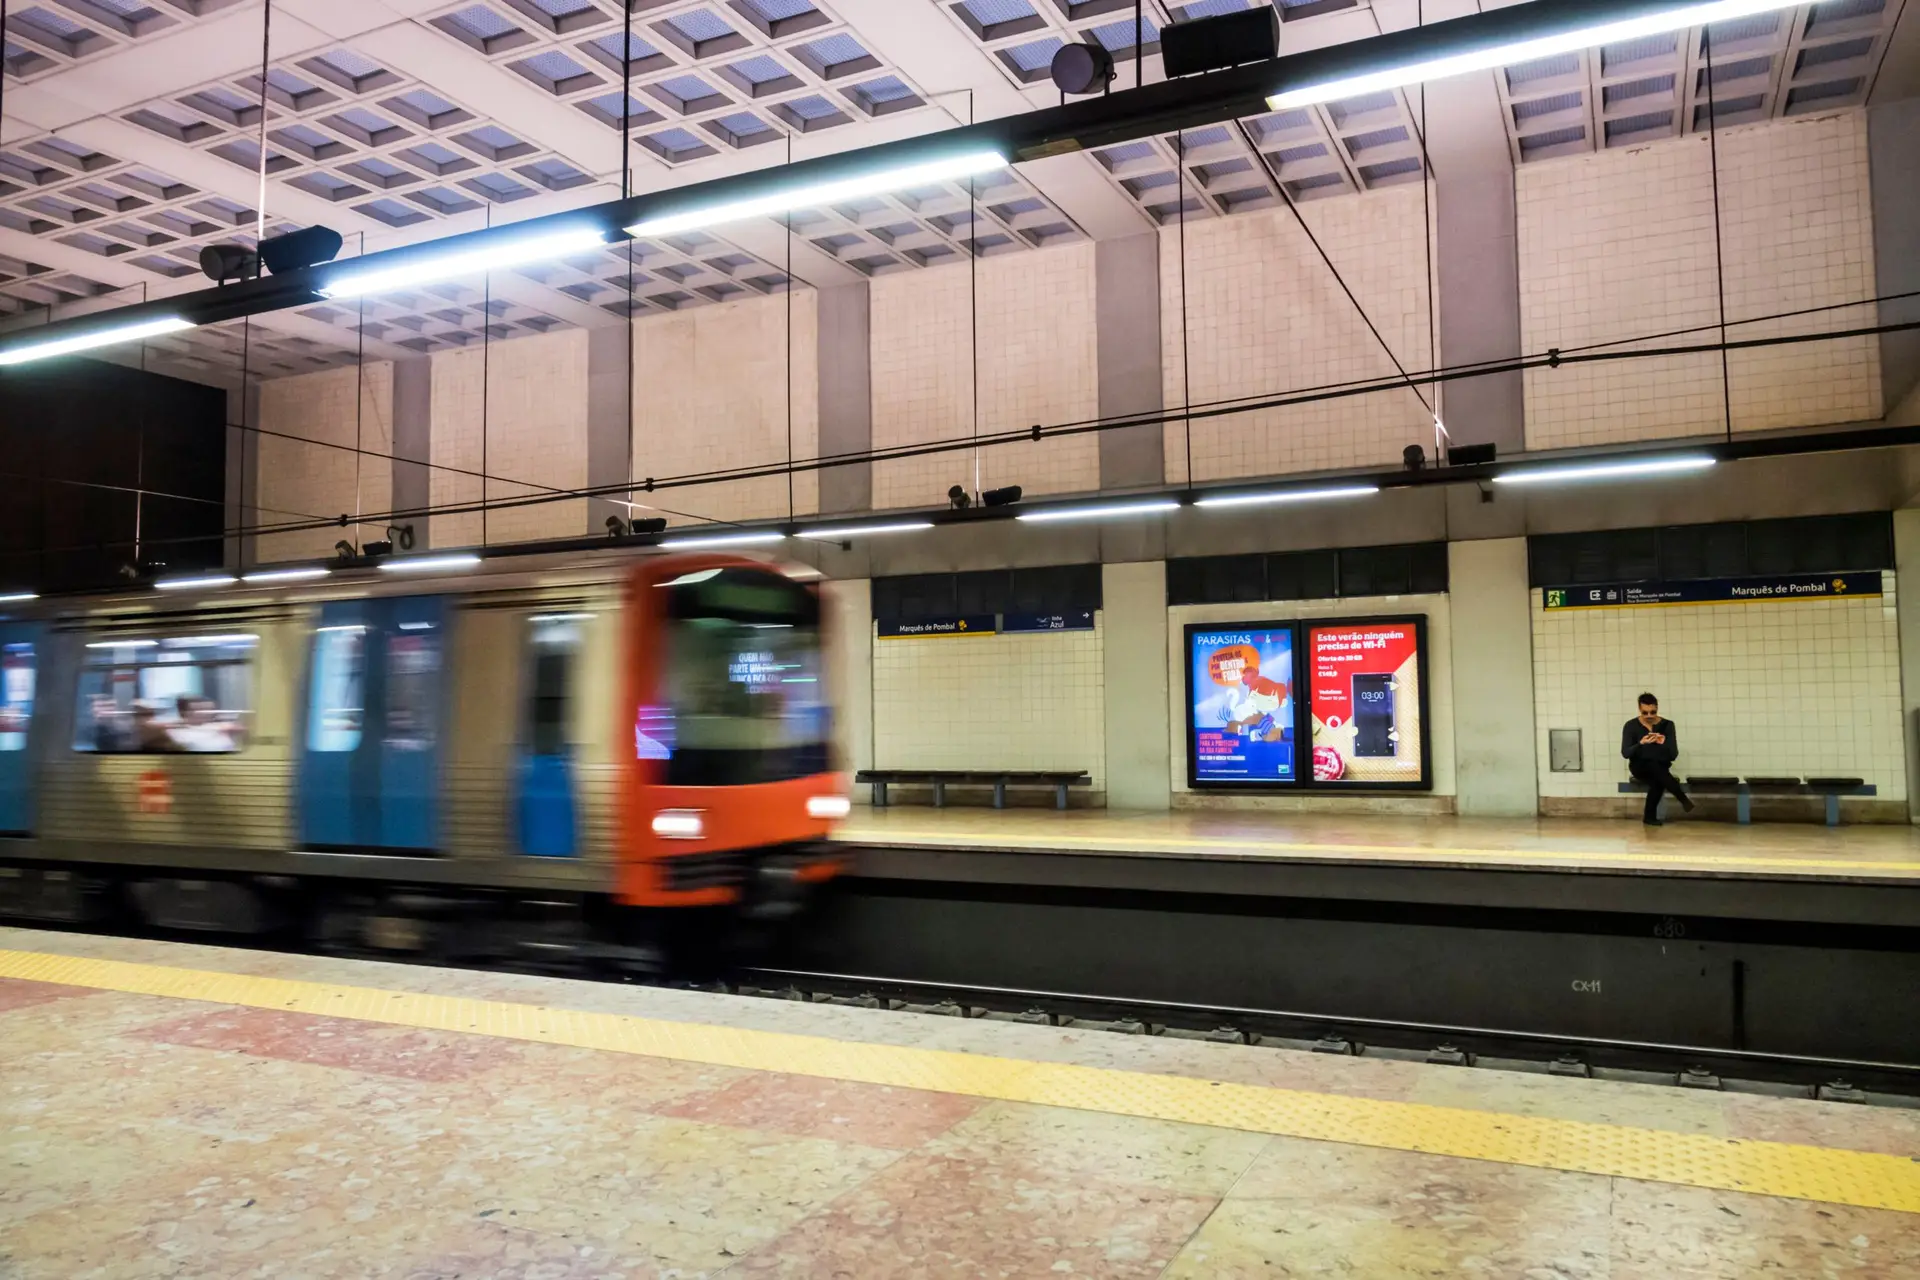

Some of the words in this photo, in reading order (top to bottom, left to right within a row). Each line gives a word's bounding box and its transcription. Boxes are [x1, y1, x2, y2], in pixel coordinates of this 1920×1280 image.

[1731, 585, 1773, 596] Marquês
[1775, 584, 1788, 594] de
[1790, 582, 1826, 593] Pombal
[899, 625, 924, 633] Marquês
[933, 622, 955, 630] Pombal
[1197, 634, 1252, 645] PARASITAS
[1265, 634, 1271, 644] &
[1317, 633, 1337, 642] Este
[1338, 632, 1362, 640] verão
[1364, 631, 1404, 641] ninguém
[1317, 642, 1349, 652] precisa
[1362, 640, 1386, 649] Wi-Fi
[1361, 692, 1384, 700] 03:00
